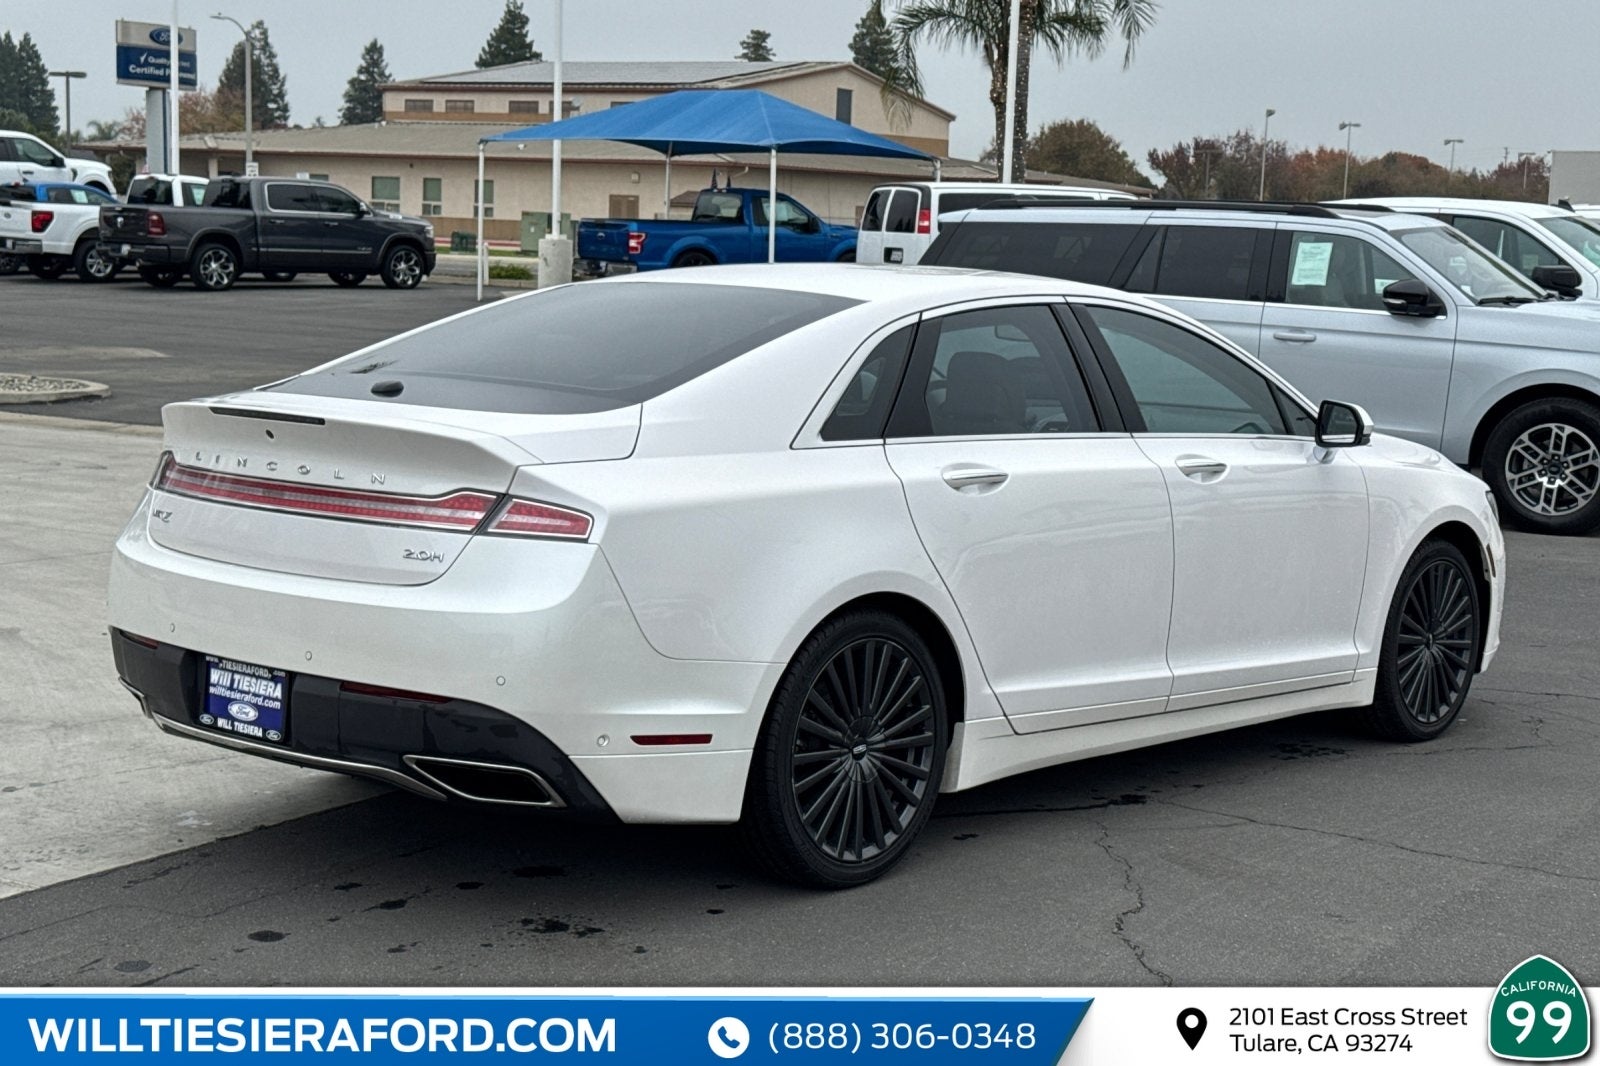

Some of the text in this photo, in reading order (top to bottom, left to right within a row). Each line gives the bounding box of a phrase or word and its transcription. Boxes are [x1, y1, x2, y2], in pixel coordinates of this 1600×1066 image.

[129, 64, 164, 76] Certified
[195, 451, 386, 485] LINCOLN
[402, 548, 444, 562] 2.0H
[210, 668, 282, 700] Will TIESIERA
[209, 685, 281, 710] willtiesieraford.com
[217, 717, 263, 738] WILL TIESIERA
